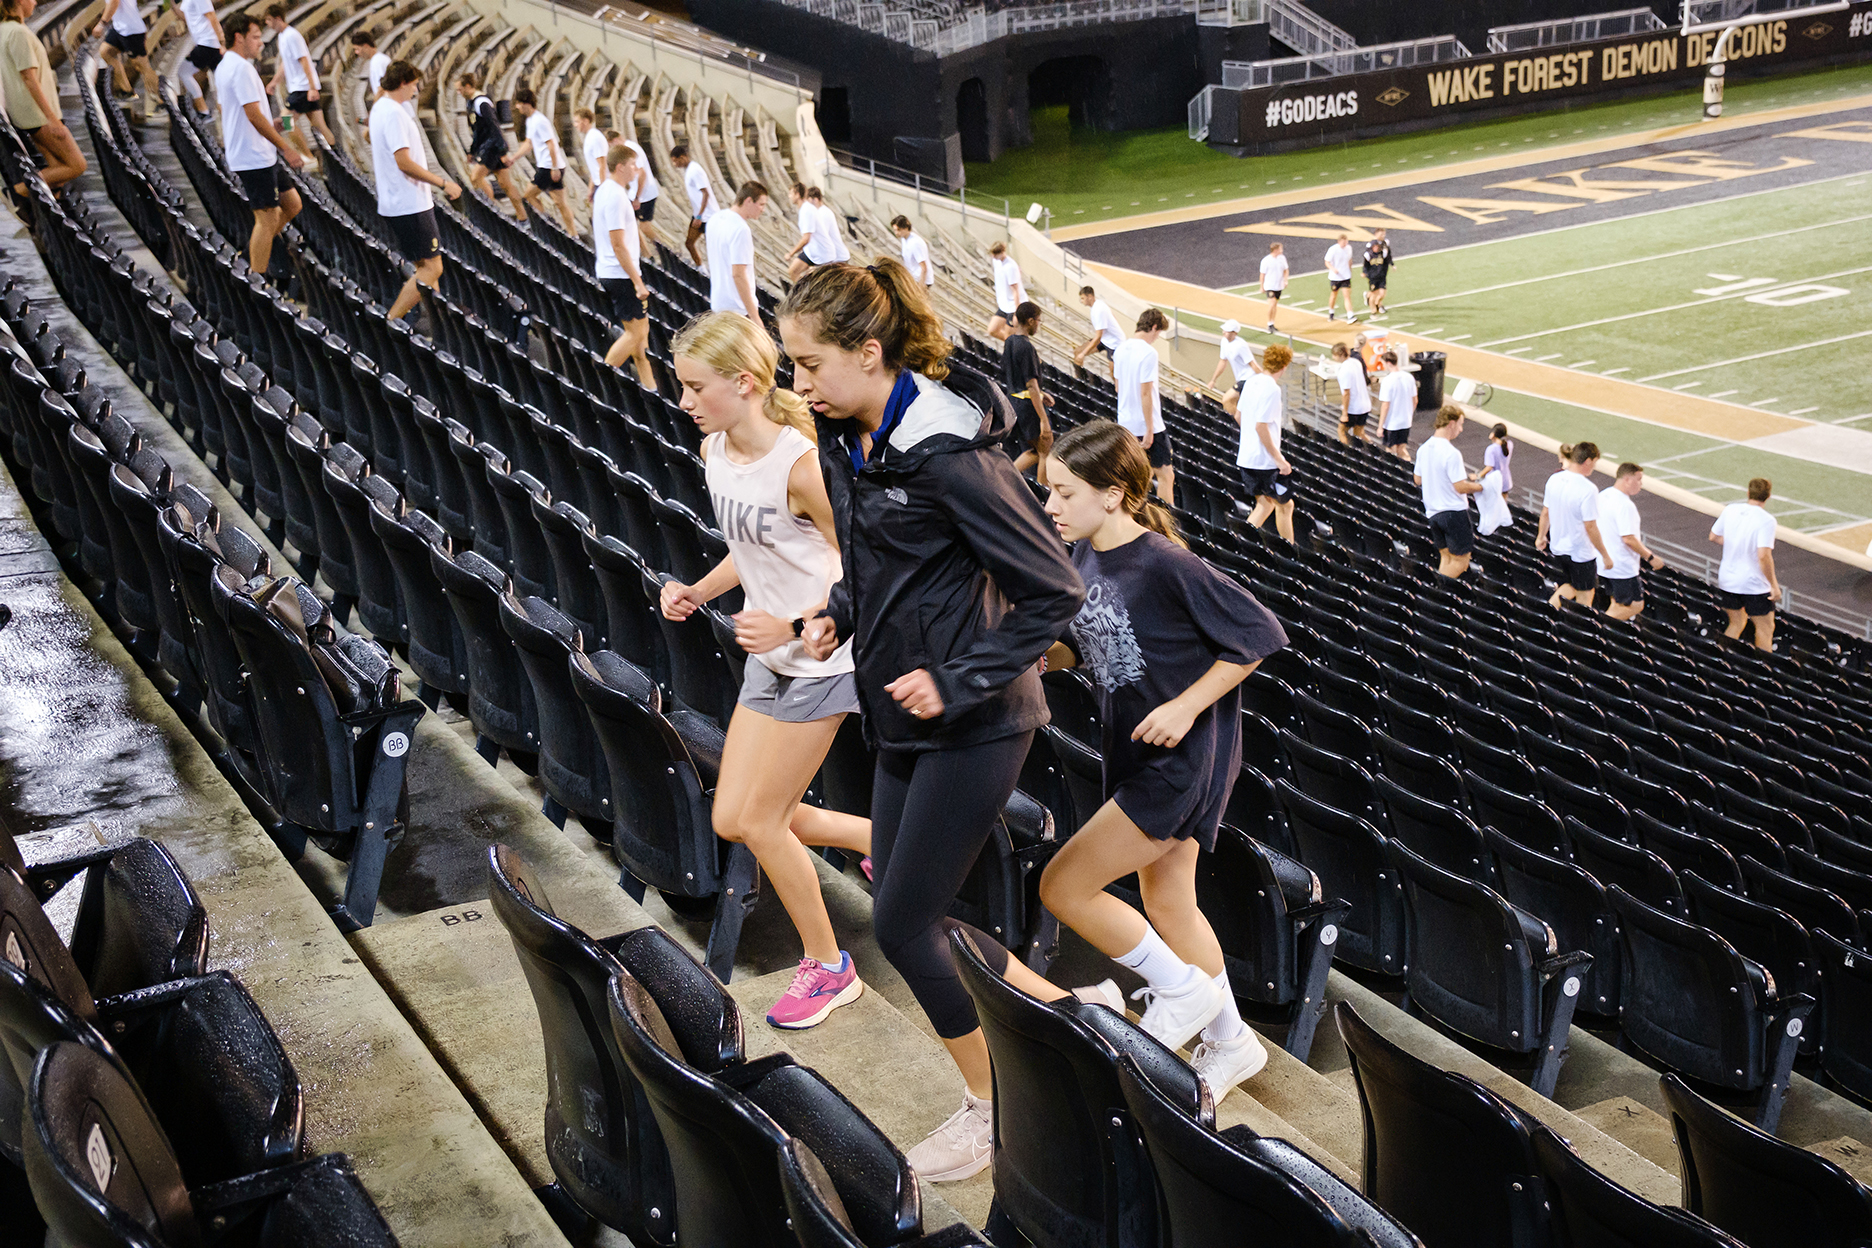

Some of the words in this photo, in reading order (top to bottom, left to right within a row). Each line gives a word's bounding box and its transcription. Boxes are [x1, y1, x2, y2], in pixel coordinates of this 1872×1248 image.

[1427, 63, 1495, 107] WAKE
[1503, 50, 1594, 96] FOREST
[1601, 37, 1678, 82] DEMON
[1265, 90, 1358, 128] #GODEACS
[1223, 149, 1817, 242] WAKE
[712, 492, 777, 549] NIKE
[388, 737, 404, 752] BB
[440, 910, 483, 927] BB
